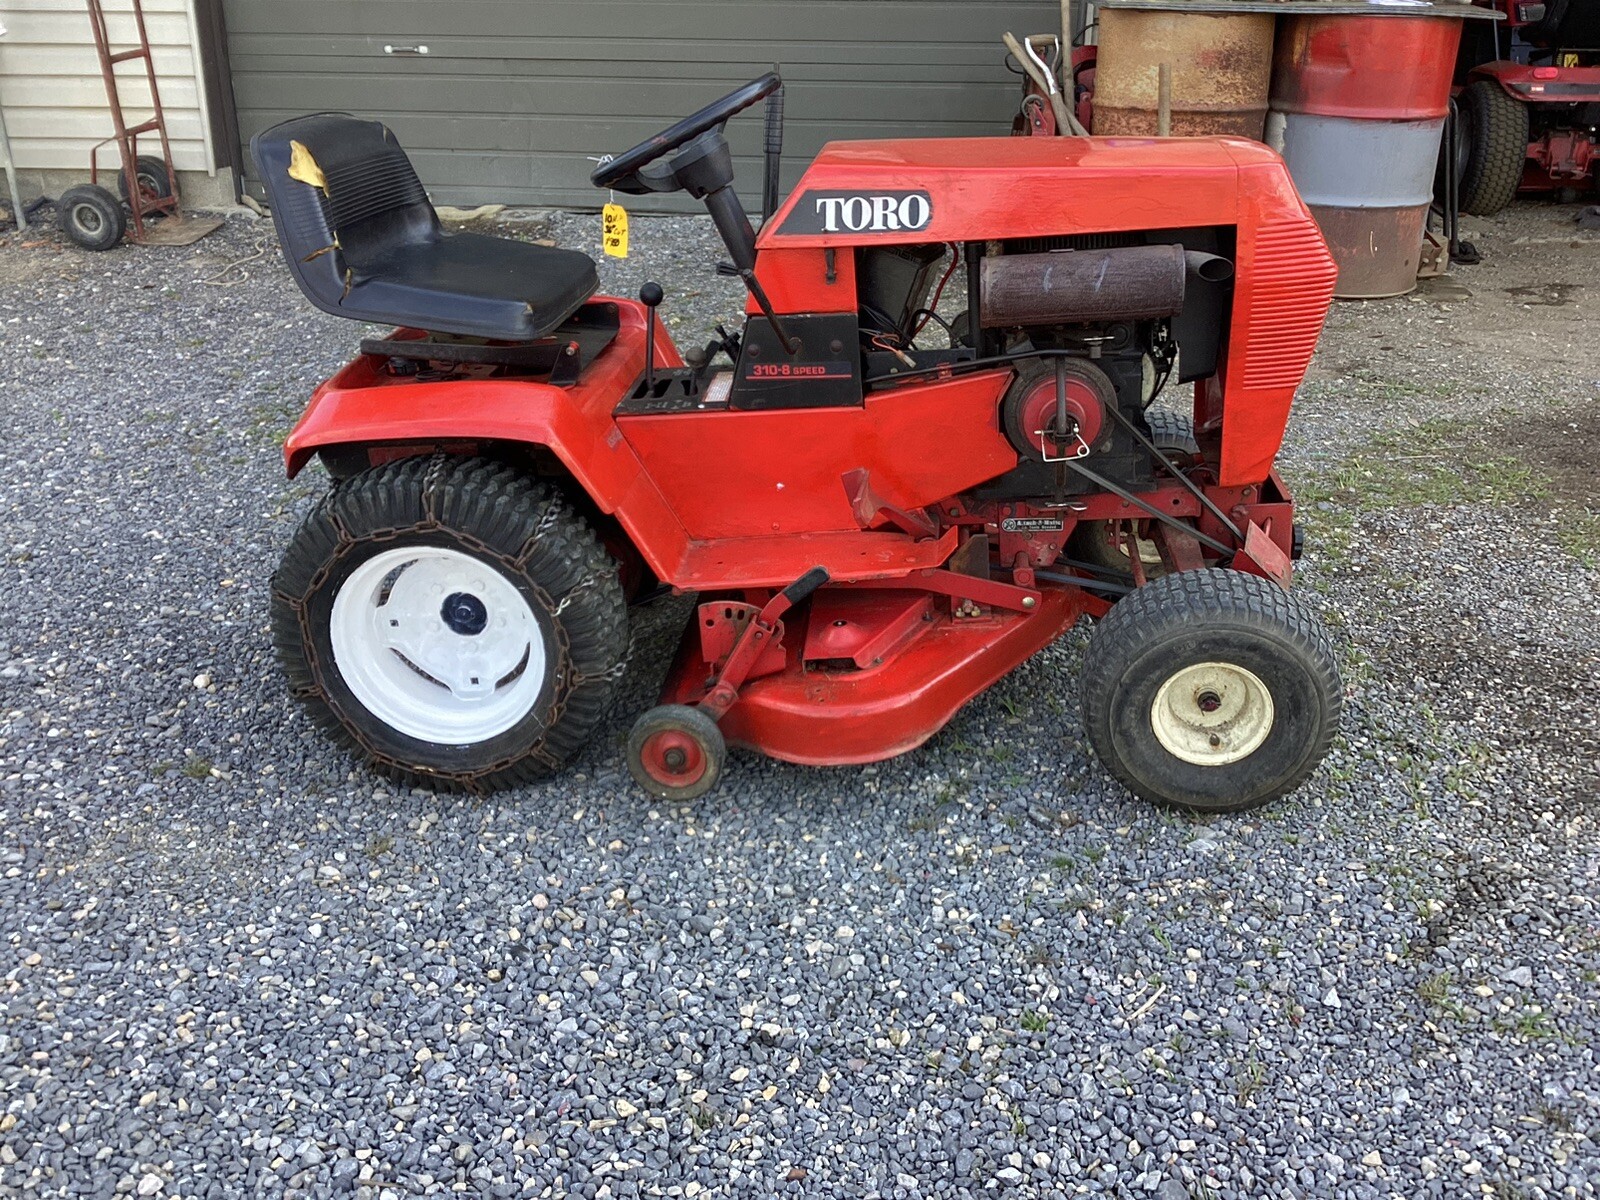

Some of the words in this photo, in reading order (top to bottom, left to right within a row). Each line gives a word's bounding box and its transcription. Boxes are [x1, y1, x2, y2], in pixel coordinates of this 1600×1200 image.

[816, 194, 930, 232] TORO
[753, 364, 791, 376] 310-8
[793, 366, 826, 375] SPEED
